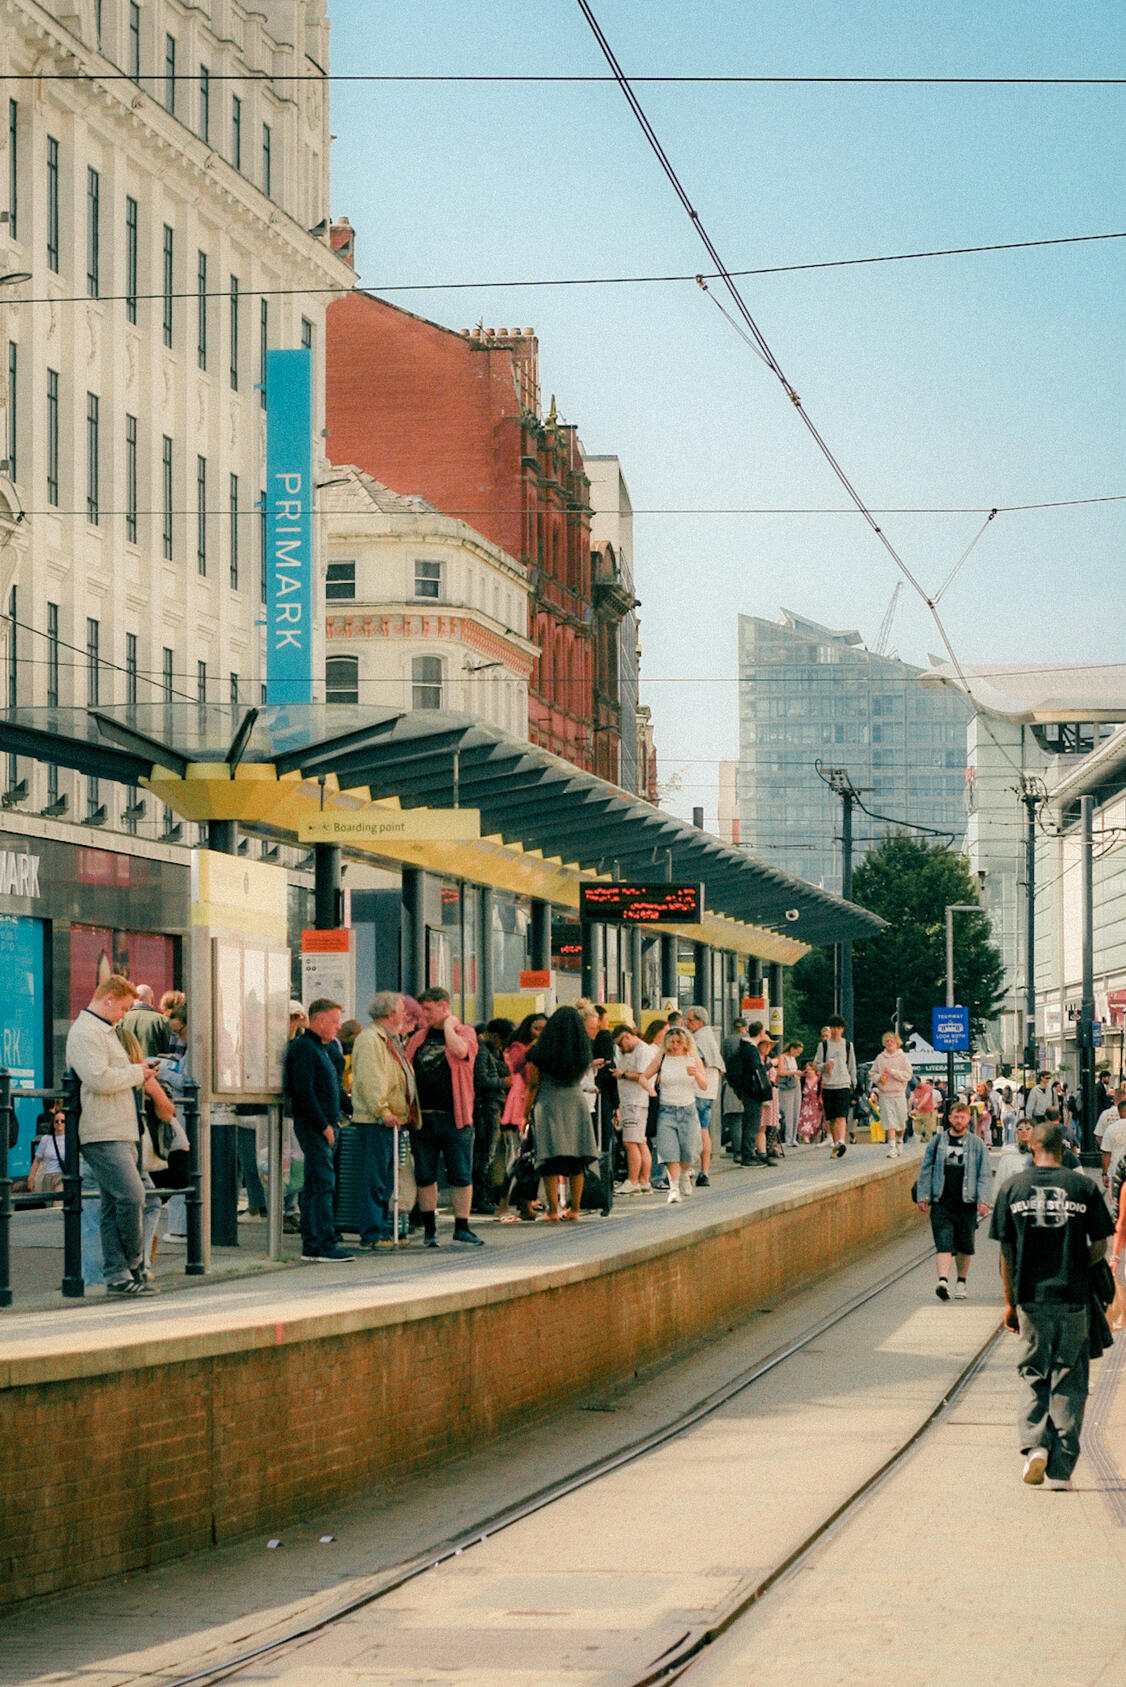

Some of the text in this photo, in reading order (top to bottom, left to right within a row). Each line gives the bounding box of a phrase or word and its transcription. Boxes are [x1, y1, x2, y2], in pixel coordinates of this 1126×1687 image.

[275, 472, 302, 650] PRIMARK
[333, 822, 405, 834] Boarding point
[1047, 1200, 1087, 1213] STUDIO
